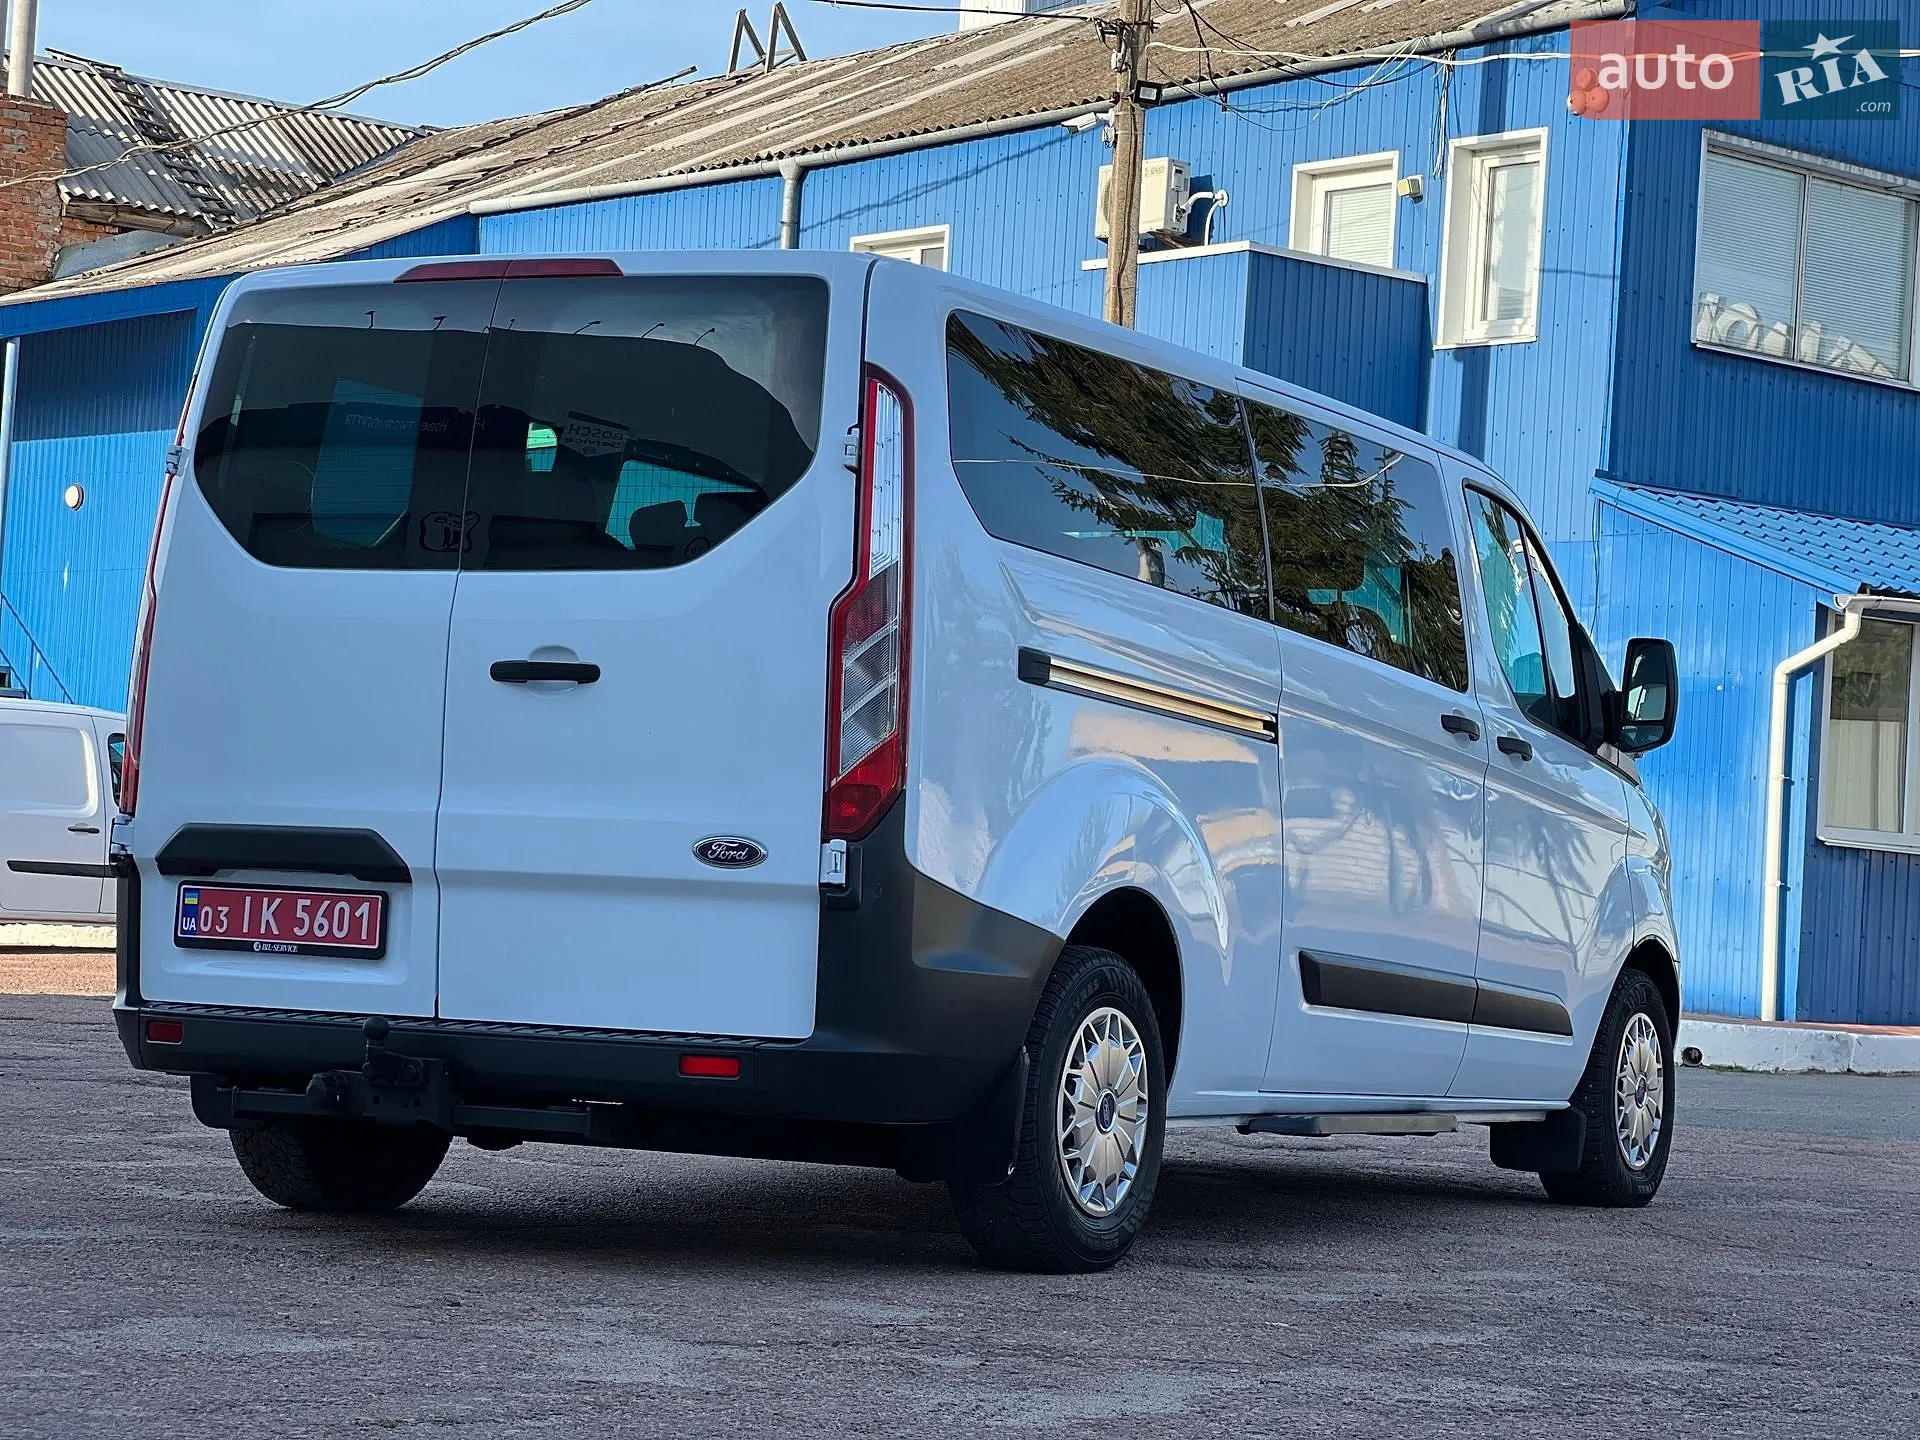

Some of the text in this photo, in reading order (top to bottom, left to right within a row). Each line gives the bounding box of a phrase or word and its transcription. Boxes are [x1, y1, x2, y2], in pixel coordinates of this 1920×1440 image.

[707, 841, 750, 860] Ford
[182, 917, 197, 932] UA
[200, 896, 371, 940] 03 IK 5601
